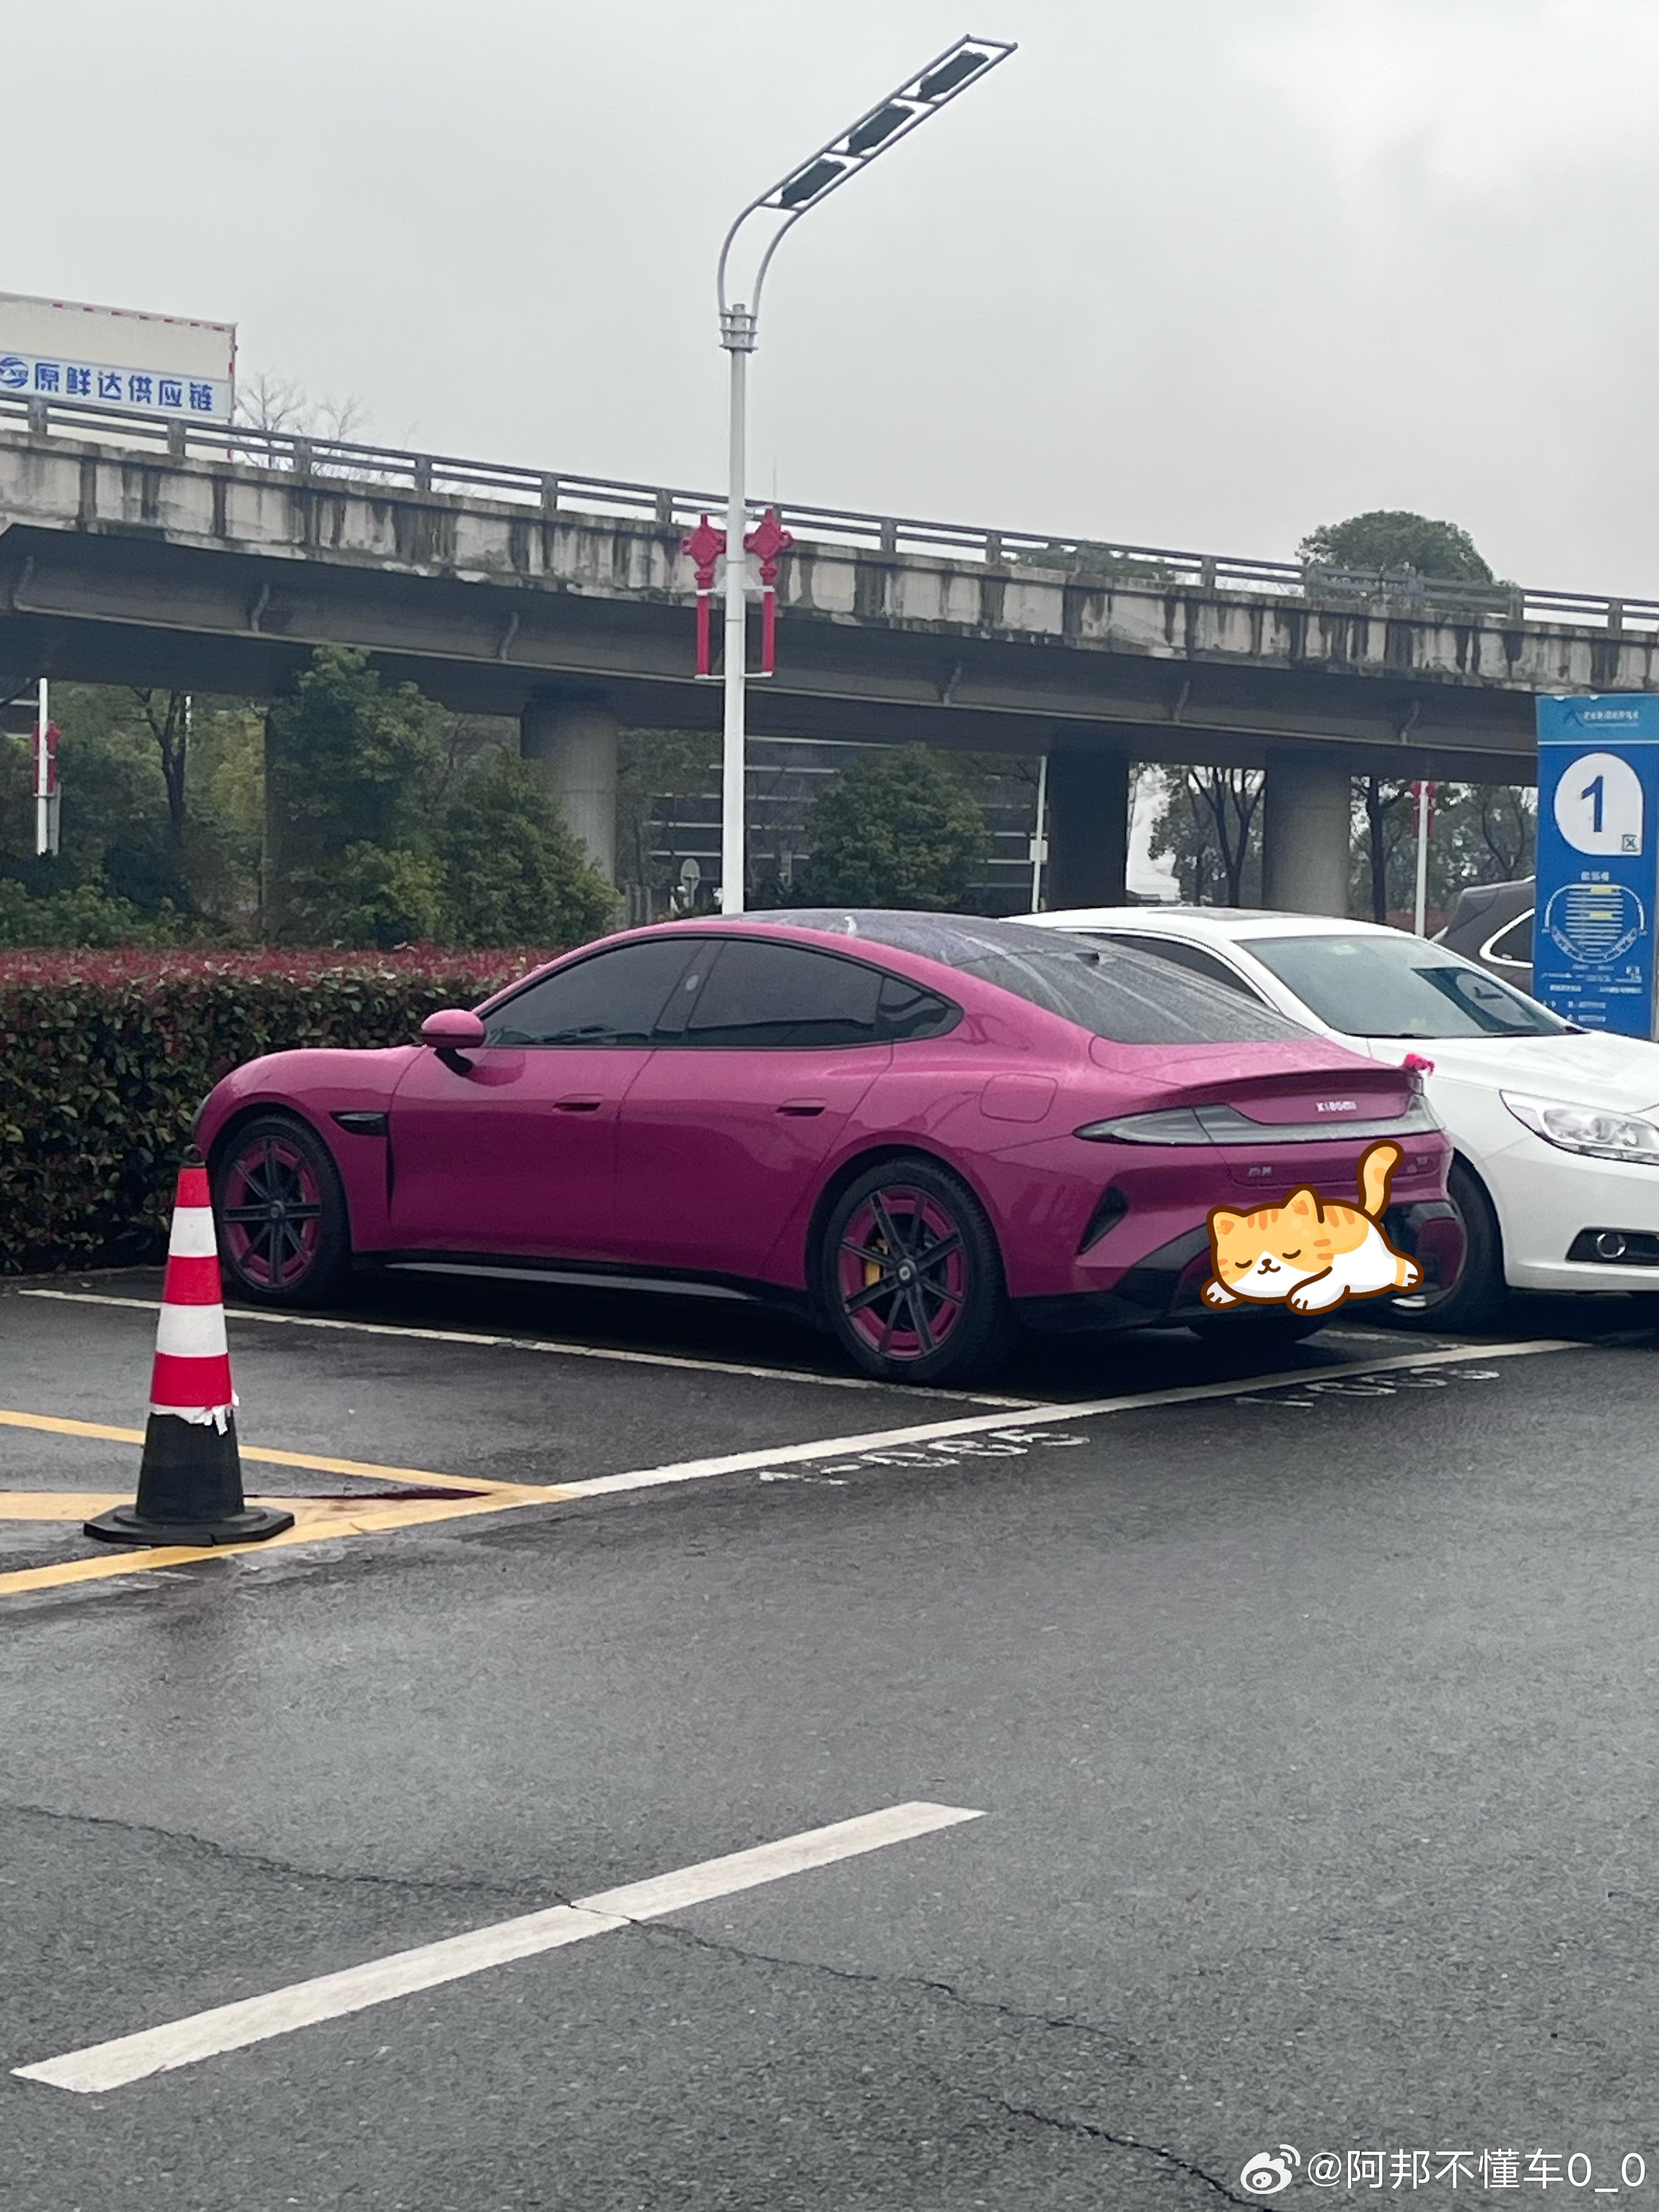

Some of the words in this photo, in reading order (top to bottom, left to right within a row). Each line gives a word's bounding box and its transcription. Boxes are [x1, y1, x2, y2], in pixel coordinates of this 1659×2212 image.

[35, 362, 213, 411] 原鲜达供应链
[1581, 774, 1604, 833] 1
